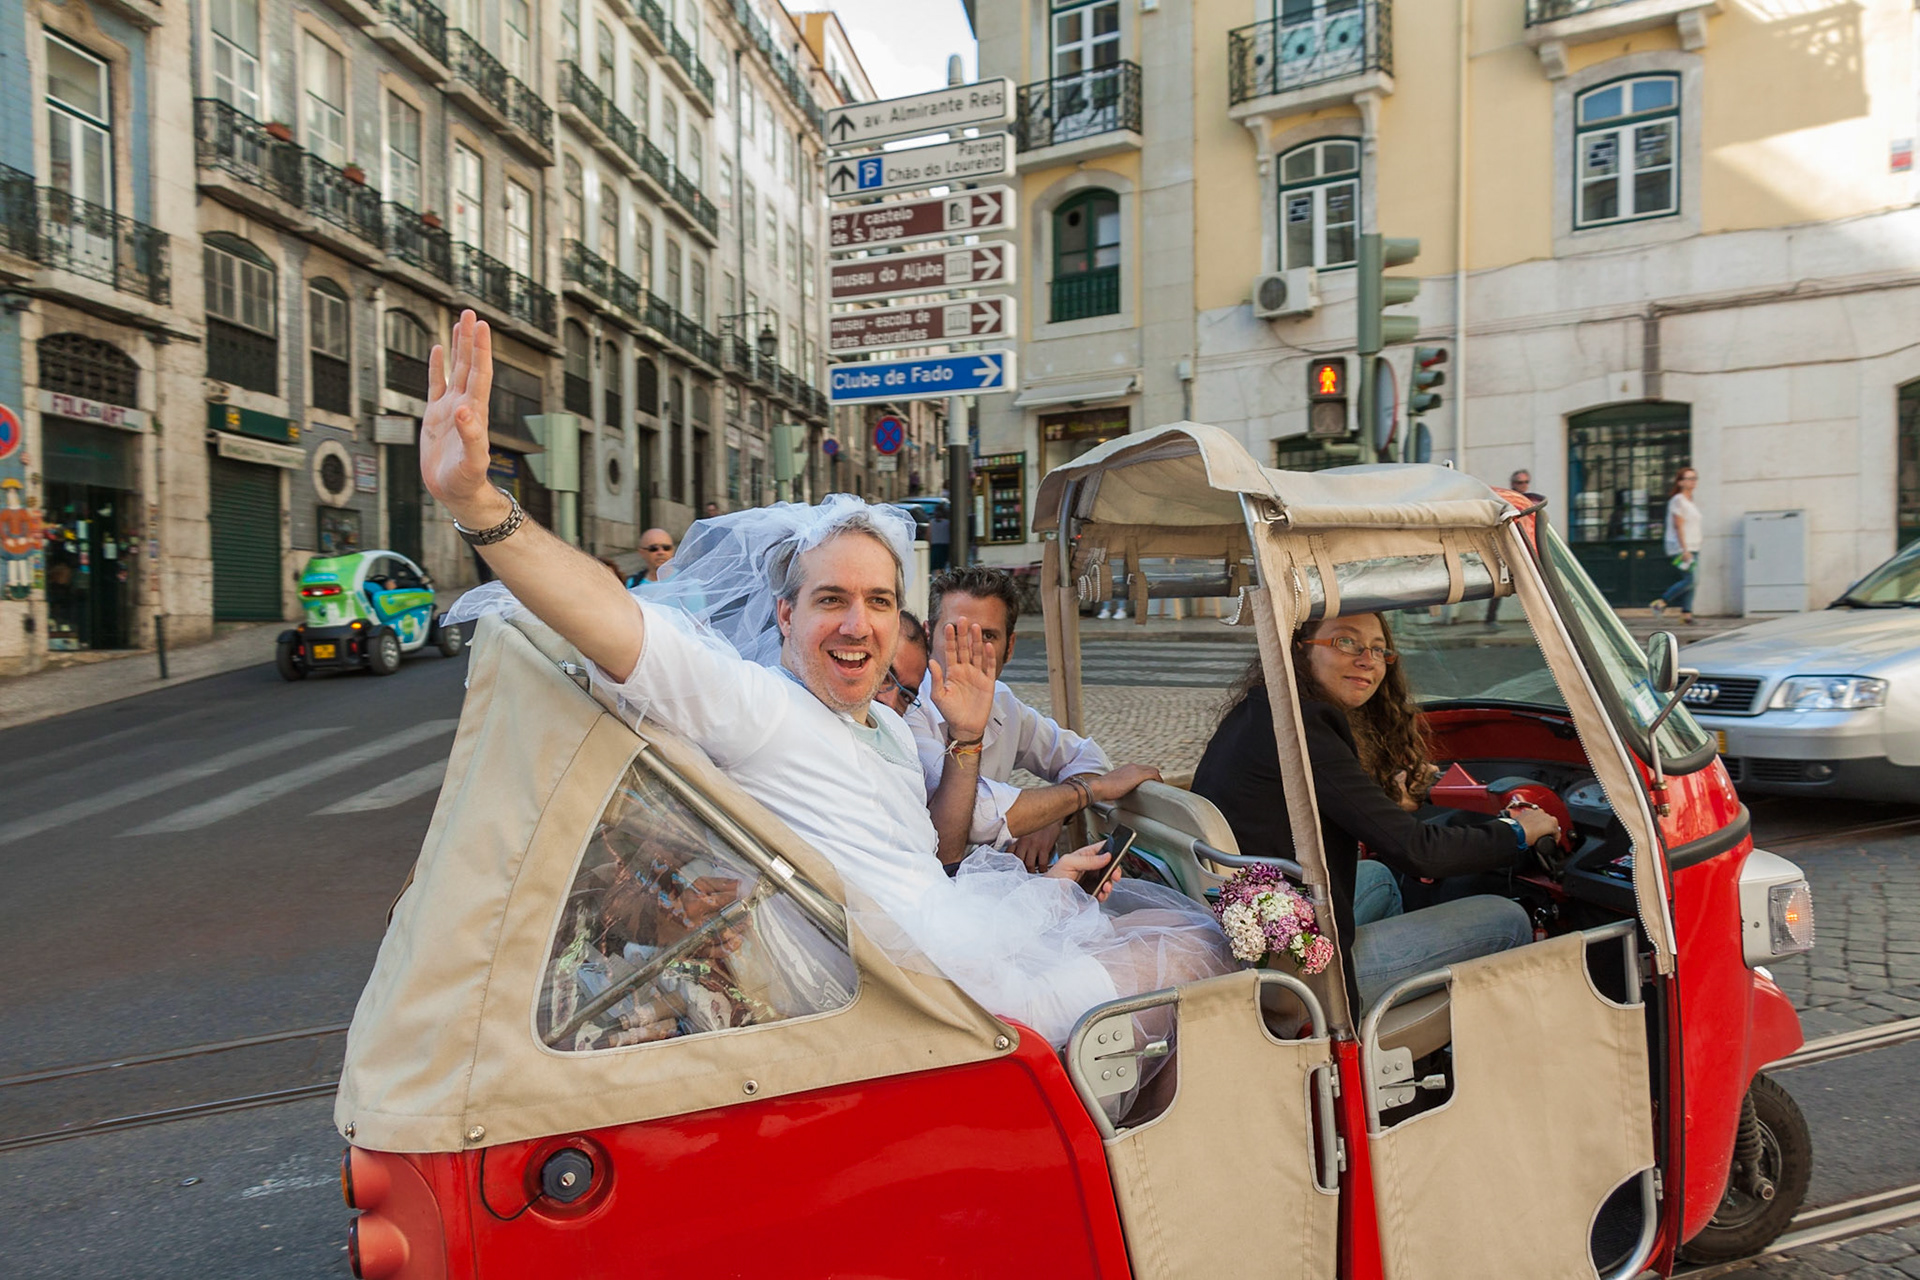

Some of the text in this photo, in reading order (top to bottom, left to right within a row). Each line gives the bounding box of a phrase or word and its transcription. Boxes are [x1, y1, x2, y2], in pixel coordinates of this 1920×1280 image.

[889, 97, 964, 123] Almirante
[969, 90, 1003, 109] Reis
[958, 141, 1001, 157] Parque
[886, 156, 1001, 182] Chão do Loureiro
[864, 208, 914, 226] castelo
[832, 231, 849, 245] de
[868, 225, 904, 242] Jorge
[832, 261, 944, 288] museu do Aljube
[831, 319, 867, 332] museu
[875, 312, 913, 328] escola
[915, 310, 931, 323] de
[832, 328, 929, 348] artes decorativas
[832, 365, 954, 390] Clube de Fado
